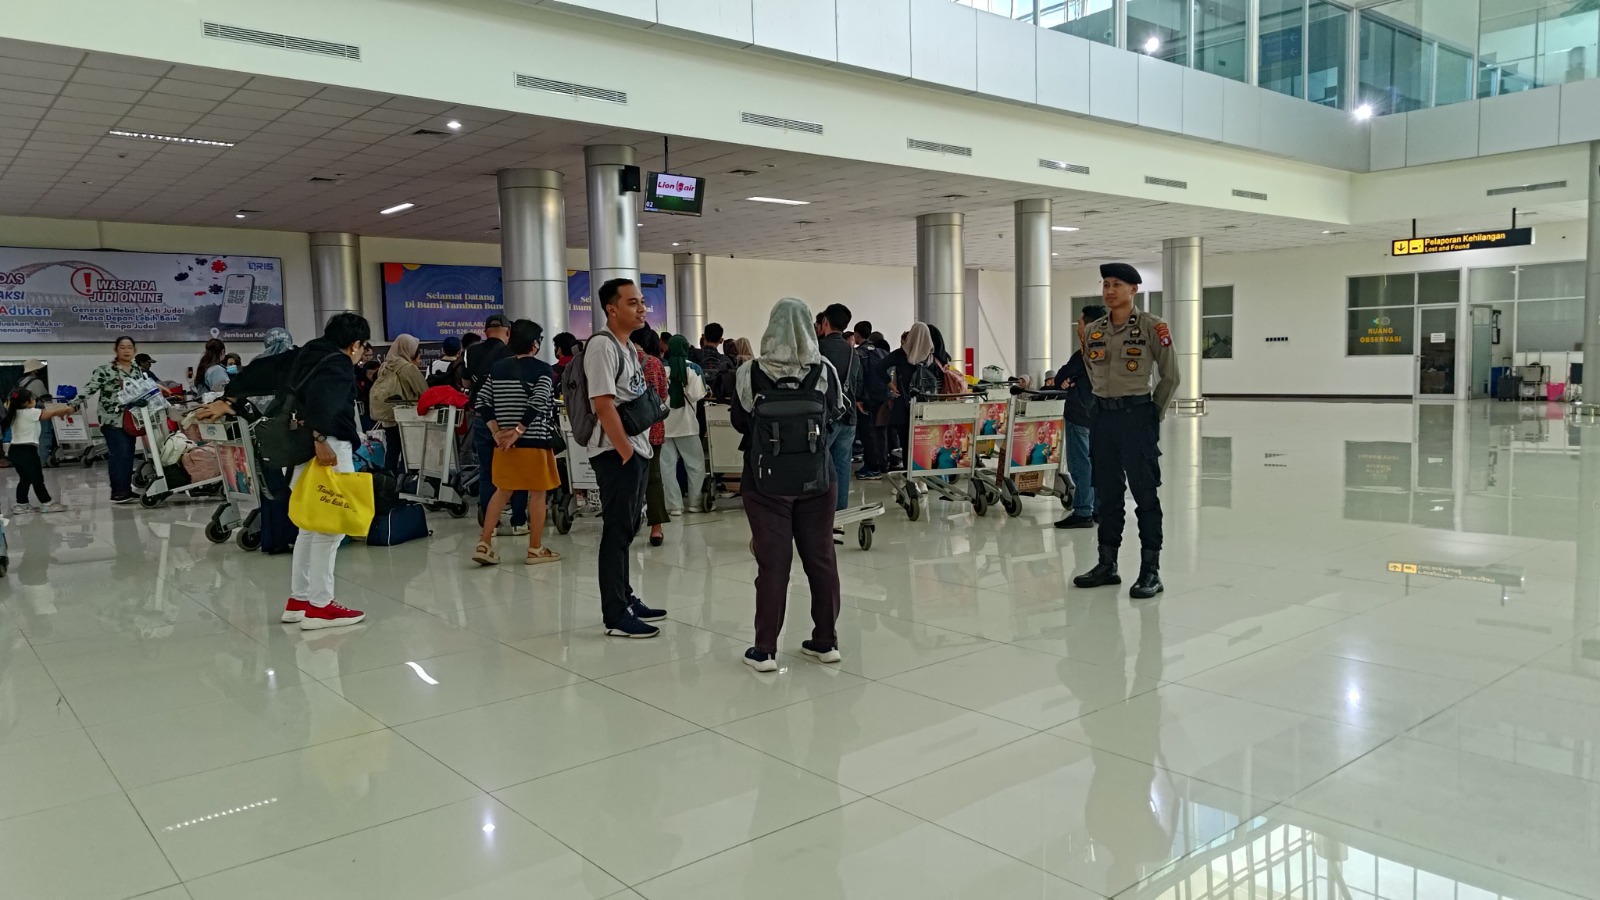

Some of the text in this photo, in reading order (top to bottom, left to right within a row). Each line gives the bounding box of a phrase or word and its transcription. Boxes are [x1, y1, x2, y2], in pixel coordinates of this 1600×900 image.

[657, 181, 695, 192] Lion air
[1424, 232, 1506, 247] Pelaporan Kehilangan
[1424, 245, 1438, 253] Lost
[1450, 243, 1470, 251] Found
[248, 261, 274, 271] QRIS
[97, 279, 157, 291] WASPADA
[89, 291, 163, 303] JUDI ONLINE
[426, 291, 495, 302] Selamat Datang
[71, 305, 111, 313] Generasi
[144, 306, 161, 314] Anti
[405, 300, 415, 309] Di
[417, 300, 443, 309] Bumi
[445, 301, 483, 310] Tambun
[106, 314, 133, 322] Depan
[105, 322, 132, 330] Tanpa
[1367, 327, 1393, 335] RUANG
[1359, 335, 1402, 344] OBSERVASI
